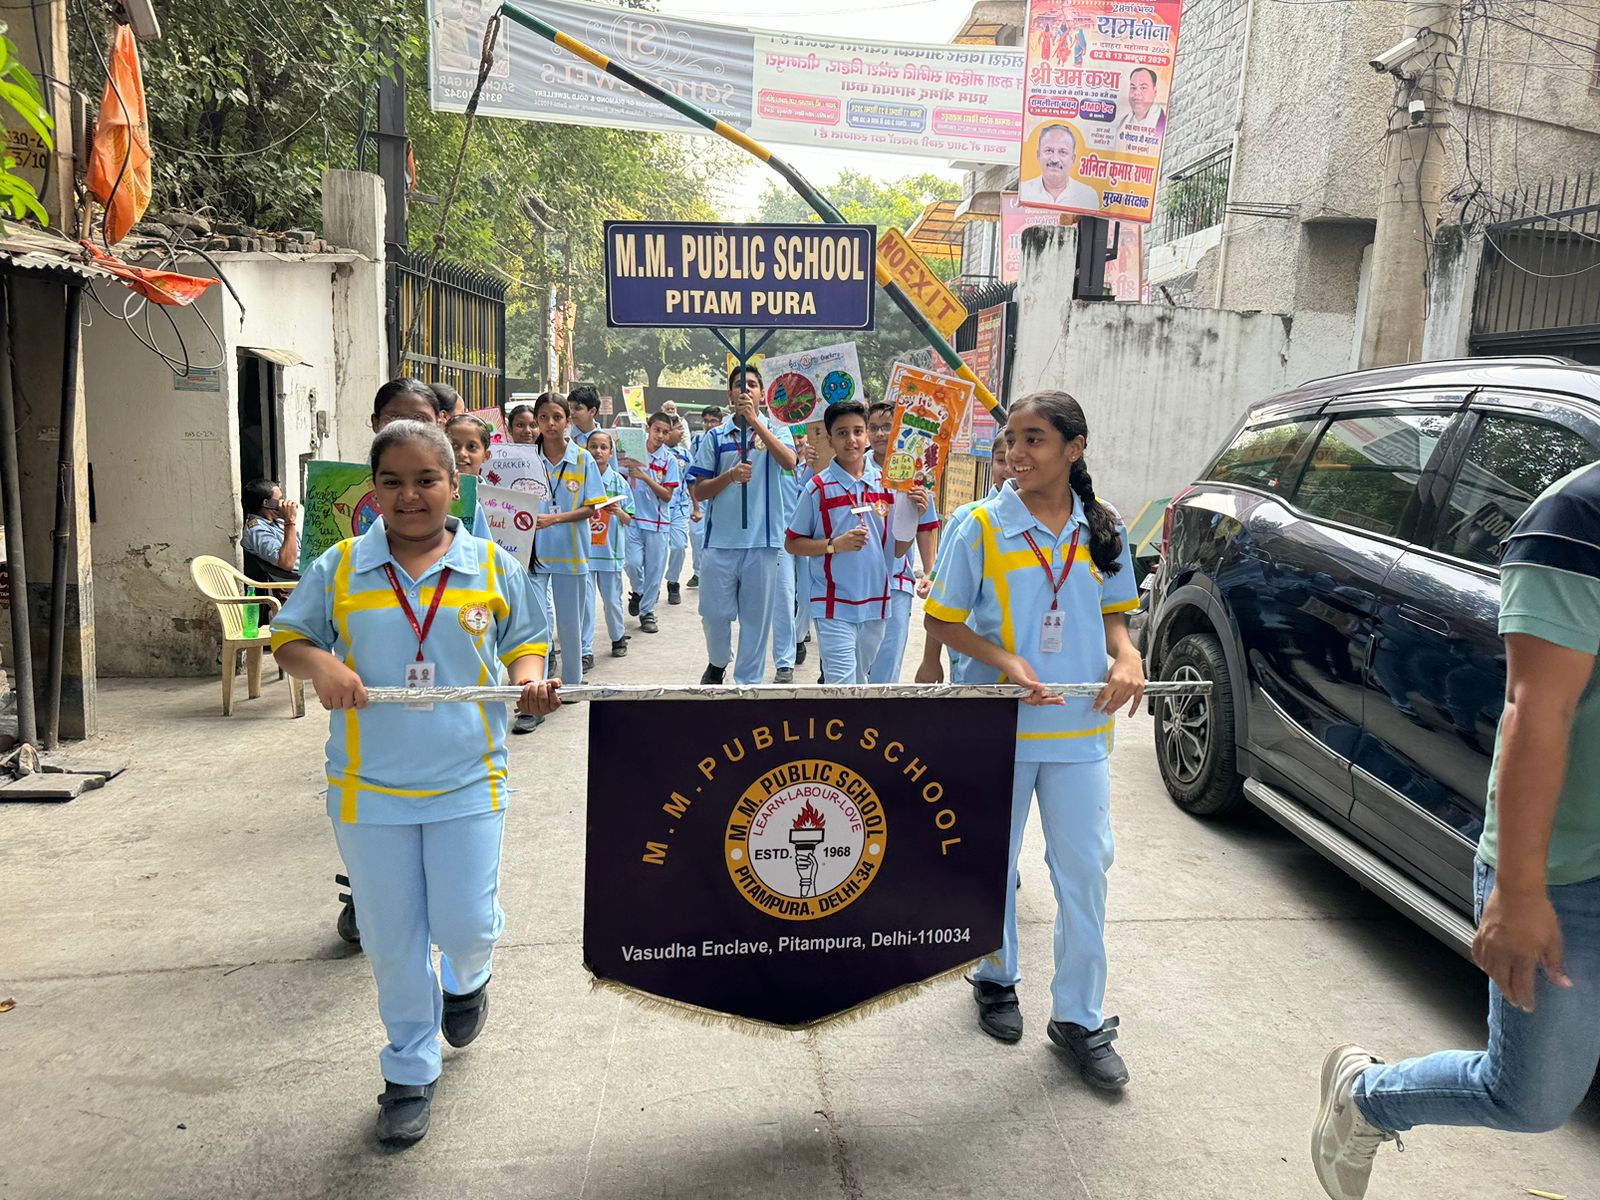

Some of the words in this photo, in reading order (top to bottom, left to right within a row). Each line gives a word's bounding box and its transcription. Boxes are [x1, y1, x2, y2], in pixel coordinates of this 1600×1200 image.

[1097, 16, 1171, 41] रामलीला
[1030, 61, 1051, 87] श्री
[1053, 68, 1083, 88] राम
[1085, 69, 1122, 91] कथा
[1080, 102, 1101, 111] JMD
[1079, 154, 1107, 178] अनिल
[1109, 159, 1134, 185] कुमार
[1134, 165, 1155, 184] राणा
[1102, 191, 1124, 208] मुख्य
[1124, 191, 1150, 208] संरक्षक
[615, 233, 673, 278] M.M.
[681, 234, 765, 281] PUBLIC
[773, 235, 865, 281] SCHOOL
[665, 289, 742, 315] PITAM
[751, 291, 817, 315] PURA
[492, 460, 532, 470] CRACKERS
[496, 450, 508, 459] TO
[697, 717, 846, 782] PUBLIC
[858, 726, 962, 856] SCHOOL
[728, 797, 764, 841] M.M.
[760, 763, 833, 795] PUBLIC
[835, 770, 884, 839] SCHOOL
[754, 848, 793, 861] ESTD.
[823, 846, 851, 858] 1968
[734, 864, 815, 916] PITAMPURA,
[818, 860, 876, 913] DELHI-34
[621, 944, 697, 962] Vasudha
[702, 939, 773, 957] Enclave,
[777, 934, 867, 953] Pitampura,
[871, 927, 971, 948] Delhi-110034
